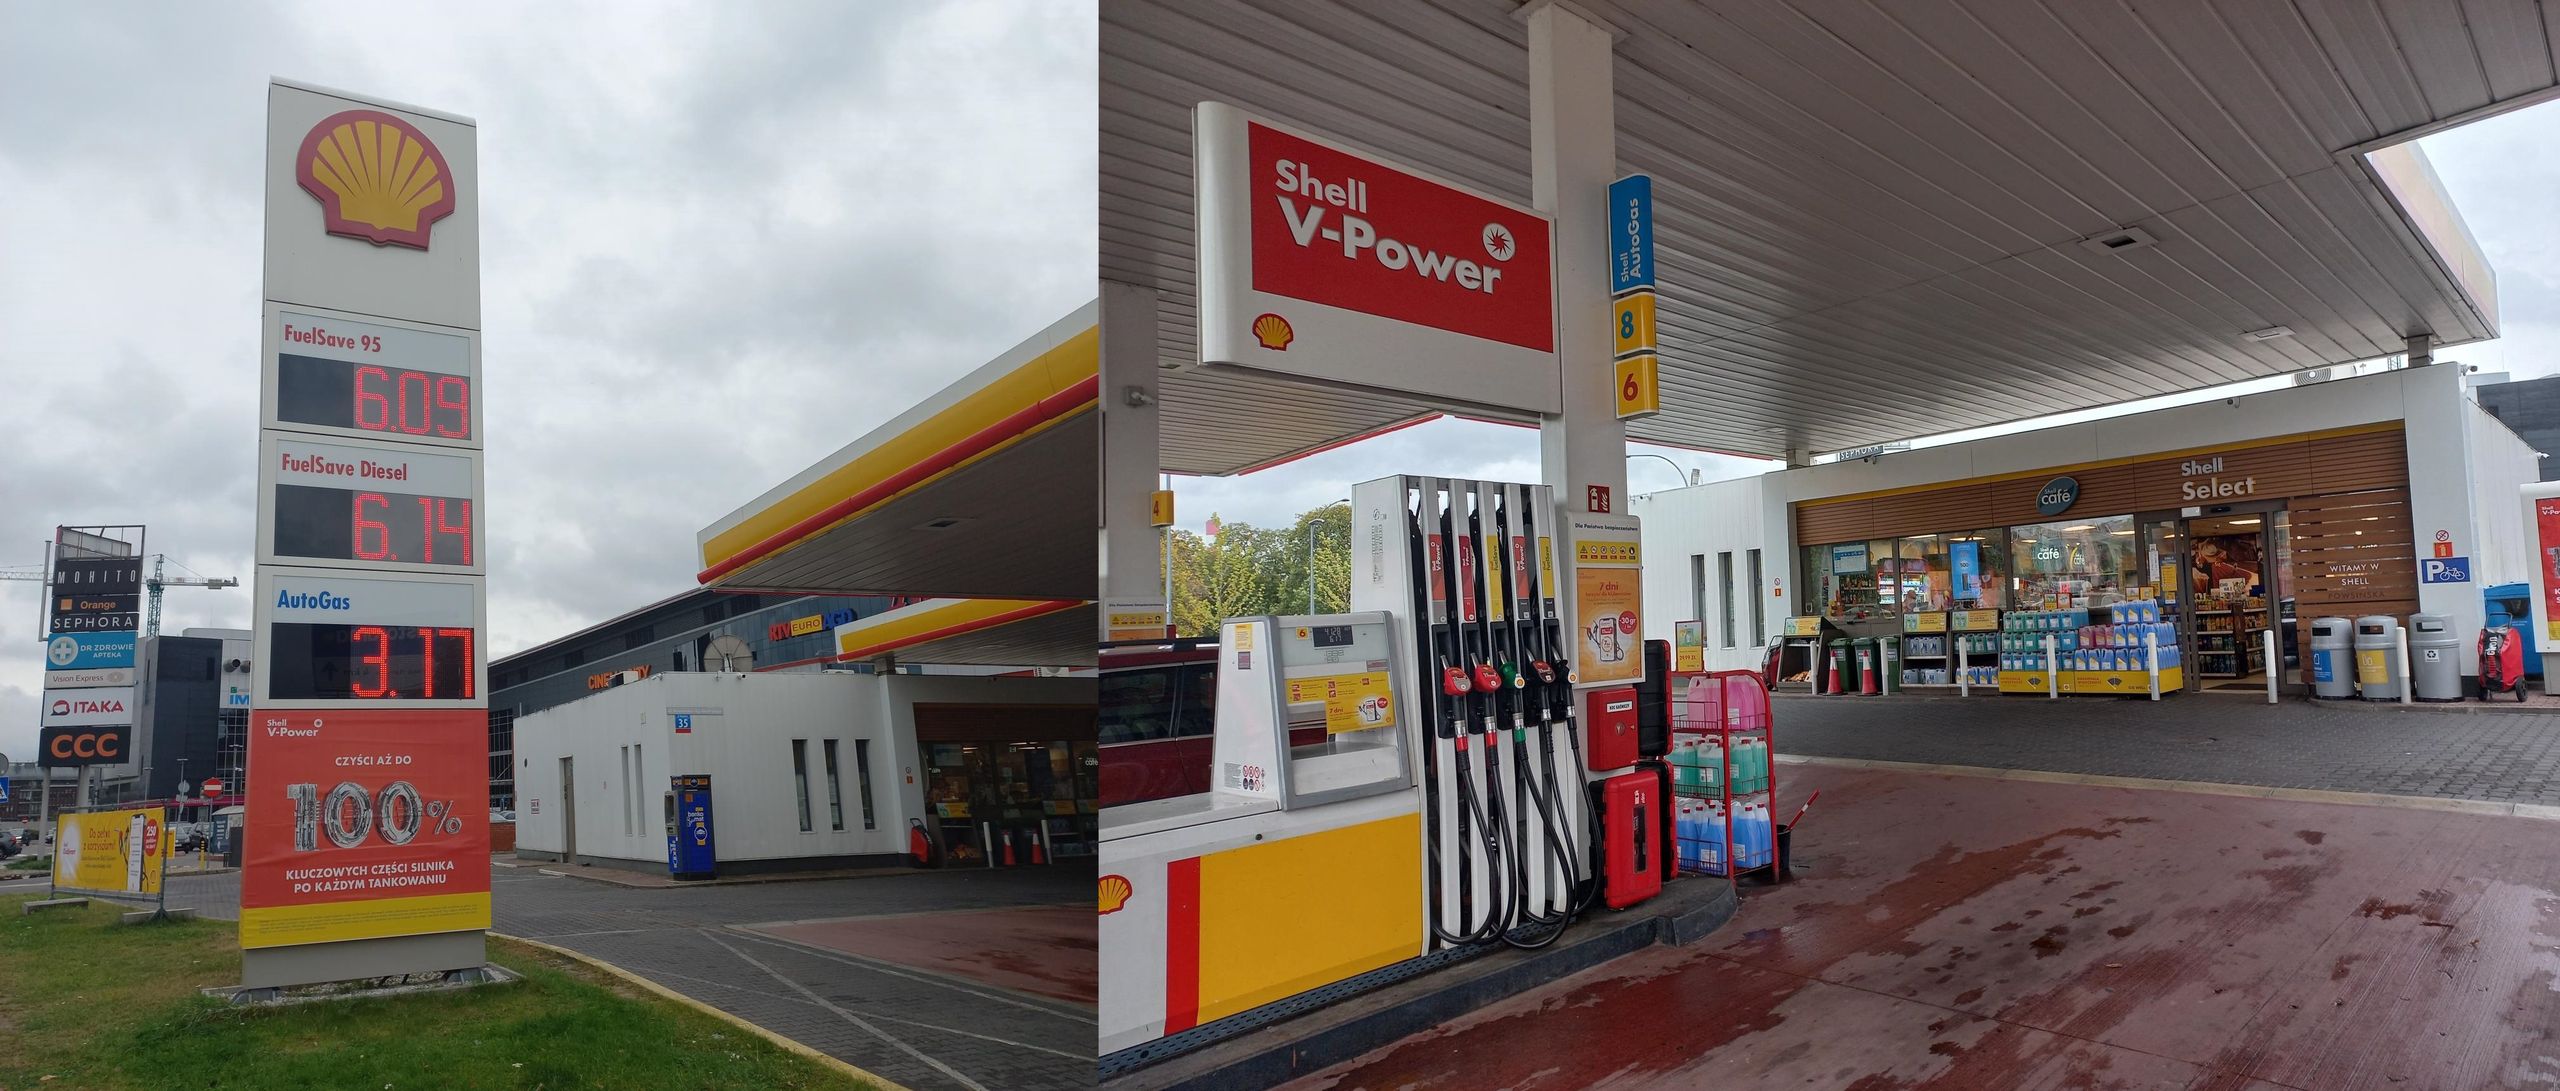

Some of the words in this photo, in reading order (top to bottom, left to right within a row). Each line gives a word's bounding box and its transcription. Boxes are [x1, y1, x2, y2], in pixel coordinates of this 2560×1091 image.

[1275, 159, 1367, 213] Shell
[1276, 196, 1501, 294] V-Power
[1629, 198, 1641, 279] AutoGas
[1621, 253, 1629, 282] Shell
[1621, 311, 1634, 338] 8
[284, 325, 355, 350] FuelSave
[361, 335, 381, 353] 95
[1623, 373, 1638, 402] 6
[356, 367, 468, 438] 6.09
[282, 454, 354, 477] FuelSave
[361, 460, 407, 481] Diesel
[2181, 456, 2223, 477] Shell
[2041, 490, 2070, 506] café
[2182, 477, 2256, 501] Select
[355, 492, 470, 565] 6.14
[2037, 549, 2060, 560] café
[58, 569, 136, 584] MOHITO
[2330, 564, 2366, 573] WITAMY
[2427, 561, 2444, 581] P
[2342, 577, 2369, 586] SHELL
[80, 600, 116, 611] Orange
[277, 590, 350, 611] AutoGas
[54, 617, 133, 629] SEPHORA
[792, 617, 821, 632] EURO
[94, 643, 134, 651] ZDROWIE
[353, 626, 474, 698] 3.17
[75, 674, 104, 683] Express
[73, 700, 124, 714] ITAKA
[267, 719, 287, 727] Shell
[267, 727, 318, 737] V-Power
[678, 718, 689, 728] 35
[51, 732, 119, 758] CCC
[335, 754, 373, 767] CZYŚCI
[377, 753, 391, 766] AŻ
[395, 755, 412, 766] DO
[286, 780, 462, 851] 100%
[286, 865, 368, 880] KLUCZOWYCH
[371, 862, 408, 878] CZĘŚCI
[411, 860, 455, 873] SILNIKA
[294, 883, 311, 894] PO
[315, 879, 365, 892] KAŻDYM
[368, 874, 447, 889] TANKOWANIU
